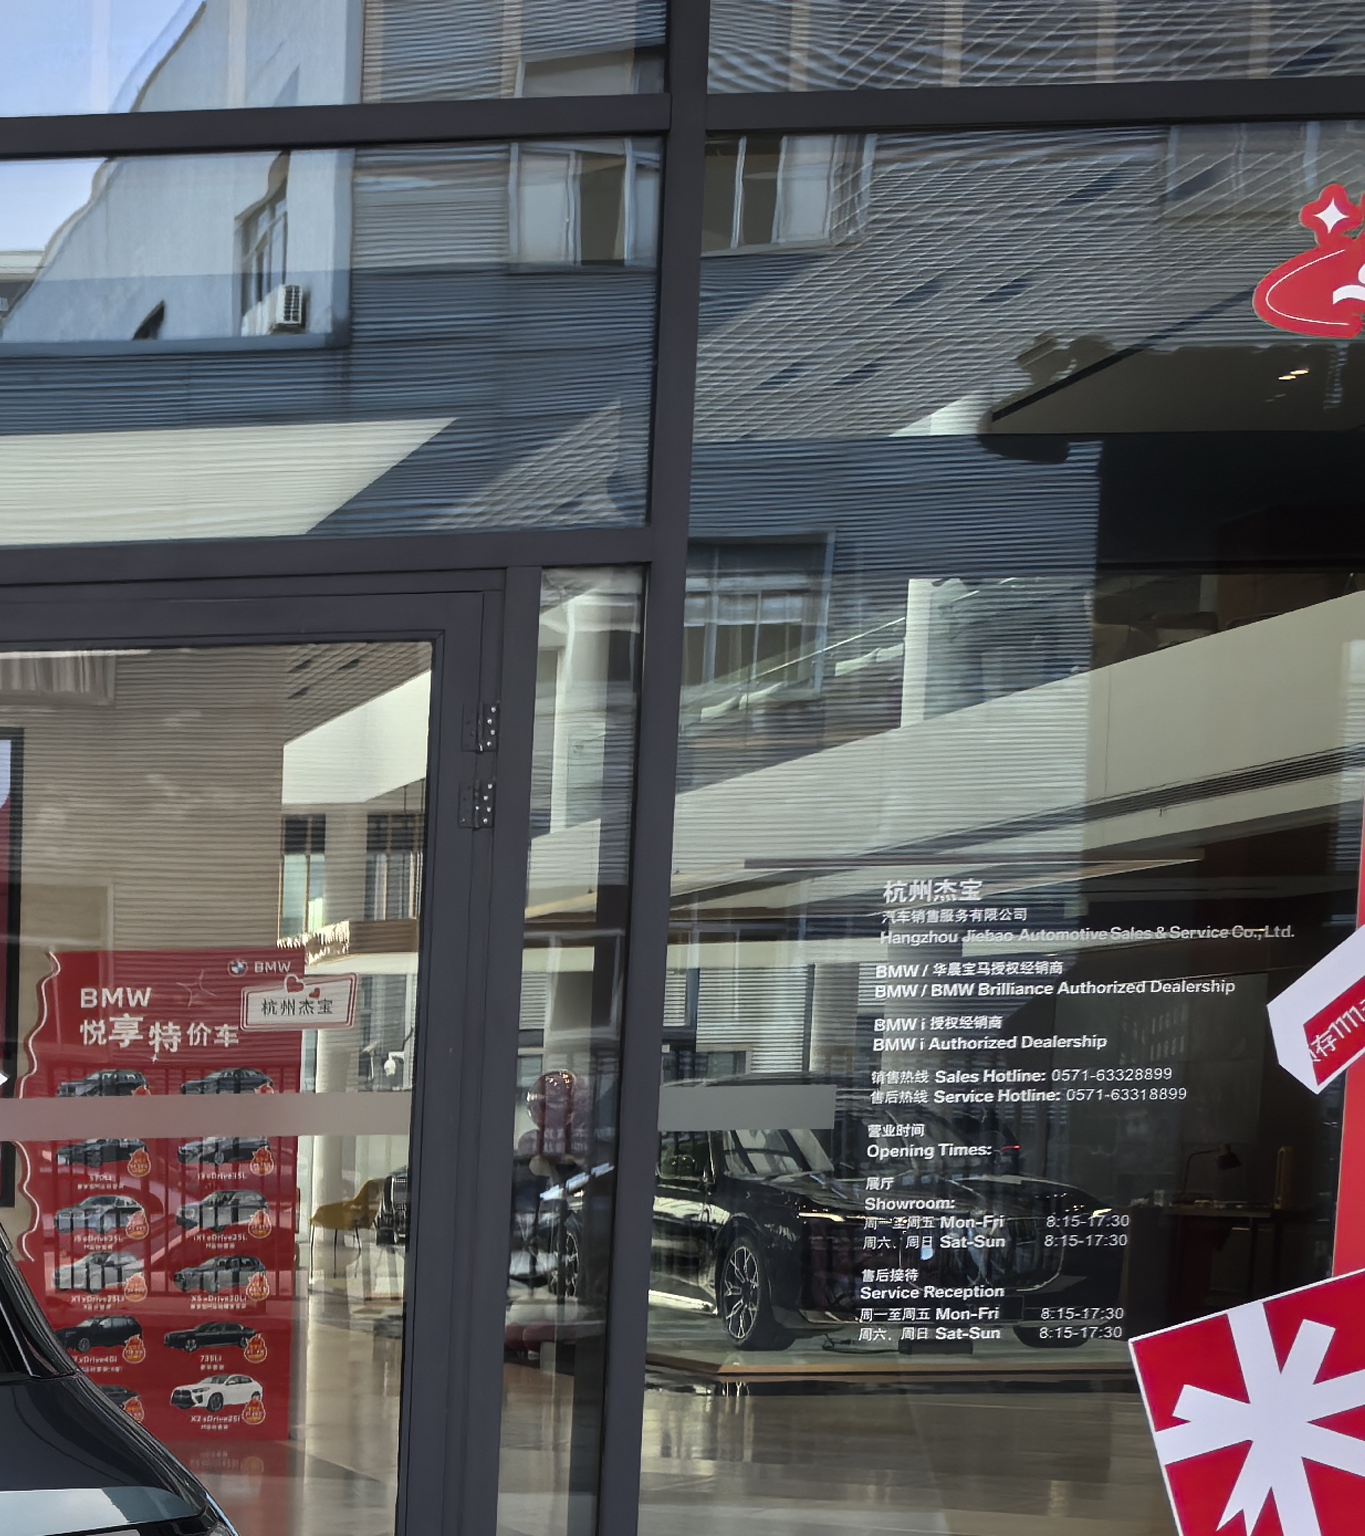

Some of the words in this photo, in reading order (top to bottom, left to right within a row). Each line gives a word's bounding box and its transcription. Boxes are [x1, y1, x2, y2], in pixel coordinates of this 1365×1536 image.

[882, 879, 983, 904] 杭州杰宝
[881, 908, 1027, 924] 汽车销售服务有限公司
[880, 930, 958, 947] Hangzhou
[962, 929, 1014, 943] Jiebao
[1018, 928, 1108, 942] Automotive
[1110, 926, 1152, 940] Sales
[1154, 926, 1165, 939] &
[1169, 925, 1228, 940] Service
[254, 961, 291, 974] BMW
[875, 964, 919, 979] BMW
[932, 961, 1064, 976] 华晨宝马授权经销商
[874, 984, 918, 999] BMW
[931, 983, 974, 997] BMW
[978, 981, 1054, 996] Brilliance
[1056, 980, 1146, 995] Authorized
[1149, 979, 1236, 995] Dealership
[80, 987, 152, 1009] BMW
[260, 997, 334, 1017] 杭州杰宝
[873, 1018, 917, 1032] BMW
[929, 1015, 1003, 1031] 授权经销商
[1307, 998, 1365, 1062] 存1111
[79, 1013, 240, 1054] 悦享特价车
[872, 1037, 917, 1052] BMW
[928, 1035, 1017, 1050] Authorized
[1021, 1034, 1108, 1050] Dealership
[871, 1070, 929, 1085] 销售热线
[934, 1070, 979, 1084] Sales
[983, 1069, 1046, 1083] Hotline:
[1051, 1067, 1173, 1082] 0571-63328899
[870, 1089, 928, 1105] 售后热线
[933, 1089, 994, 1104] Service
[997, 1088, 1061, 1103] Hotline:
[1066, 1087, 1187, 1102] 0571-63318899
[868, 1123, 925, 1138] 营业时间
[867, 1144, 935, 1160] Opening
[938, 1143, 993, 1157] Times:
[865, 1177, 895, 1191] 展厅
[864, 1197, 956, 1211] Showroom:
[863, 1215, 936, 1231] 周一至周五
[940, 1215, 1006, 1229] Mon-Fri
[1046, 1214, 1130, 1228] 8:15-17:30
[940, 1235, 1006, 1249] Sat-Sun
[1044, 1234, 1127, 1248] 8:15-17:30
[861, 1268, 919, 1283] 售后接待
[860, 1286, 919, 1300] Service
[923, 1285, 1005, 1301] Reception
[860, 1307, 931, 1322] 周一至周五
[935, 1307, 1000, 1321] Mon-Fri
[1040, 1307, 1124, 1320] 8:15-17:30
[935, 1326, 1001, 1340] Sat-Sun
[1039, 1326, 1123, 1339] 8:15-17:30
